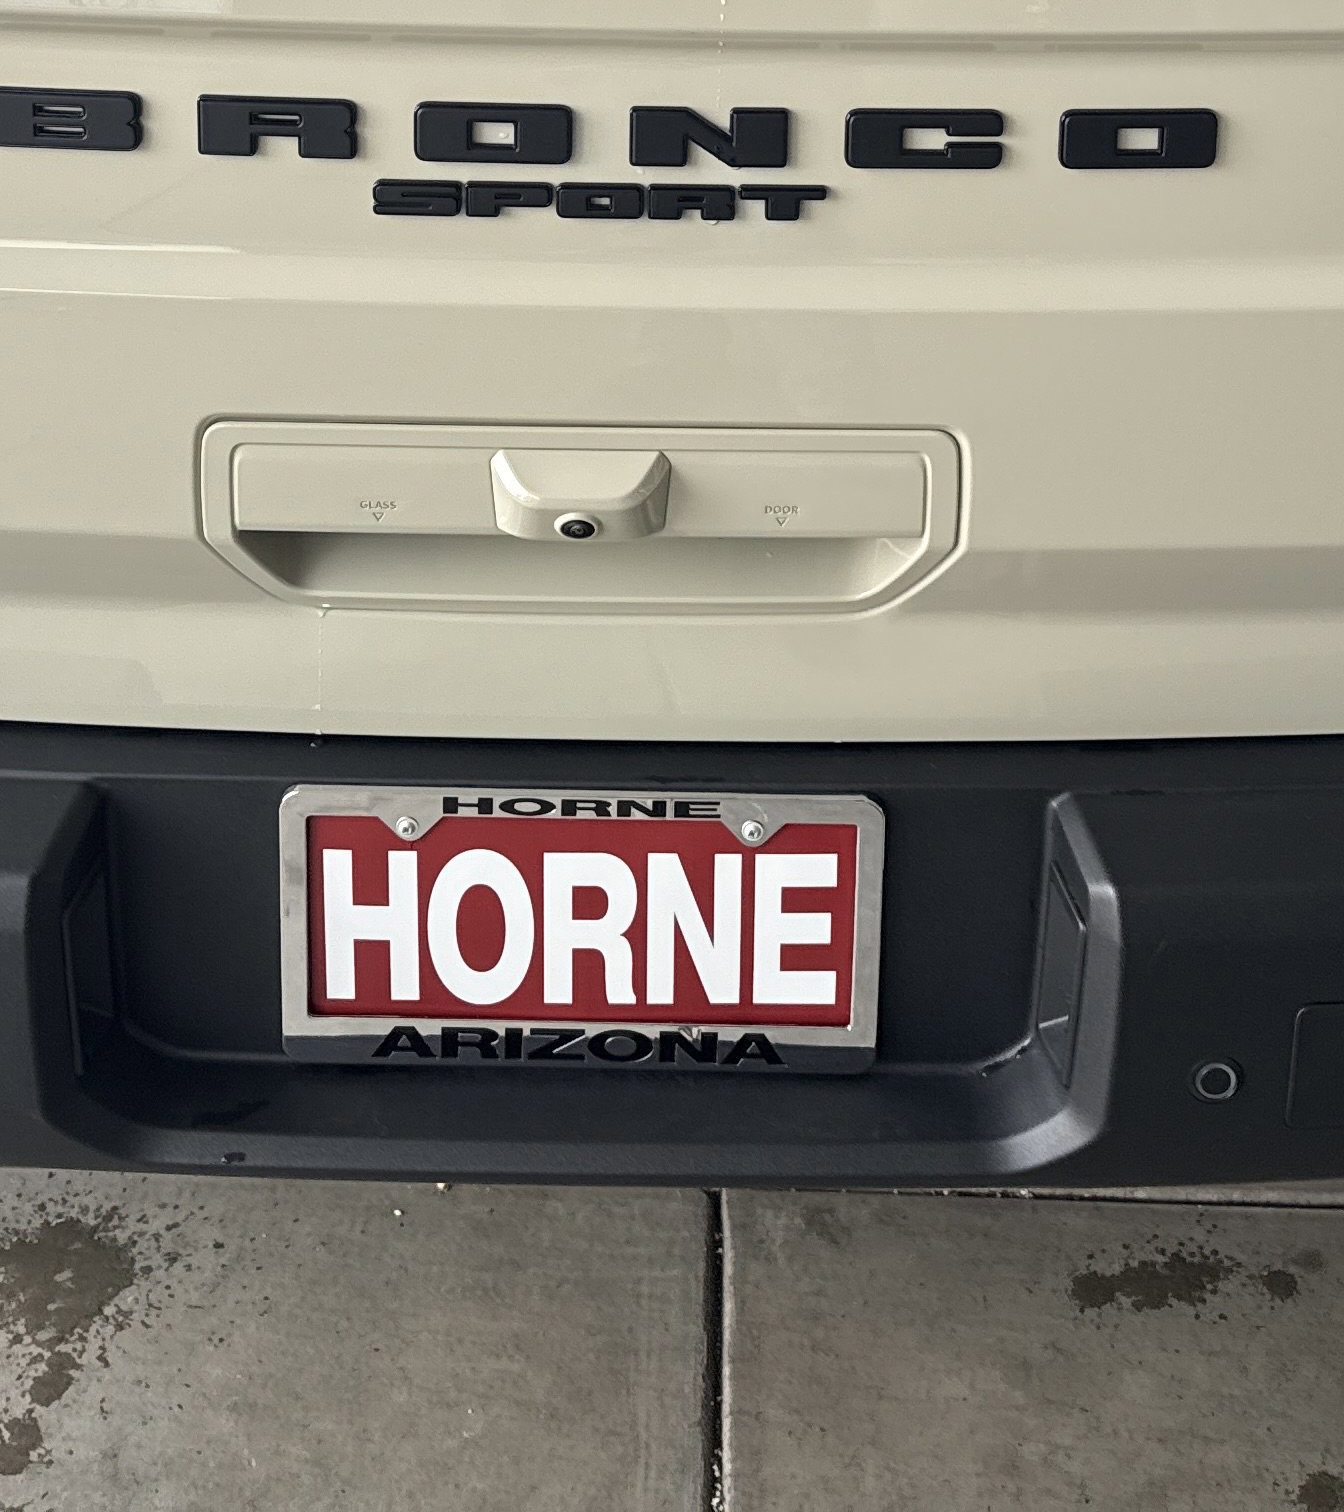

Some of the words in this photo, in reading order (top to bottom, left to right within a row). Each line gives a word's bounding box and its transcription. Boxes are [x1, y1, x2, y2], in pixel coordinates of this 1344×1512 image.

[372, 179, 828, 221] SPORT
[359, 500, 398, 510] GLASS
[764, 504, 800, 515] DOOR
[442, 796, 722, 819] HORNE
[322, 848, 839, 1006] HORNE
[371, 1024, 787, 1067] ARIZONA
